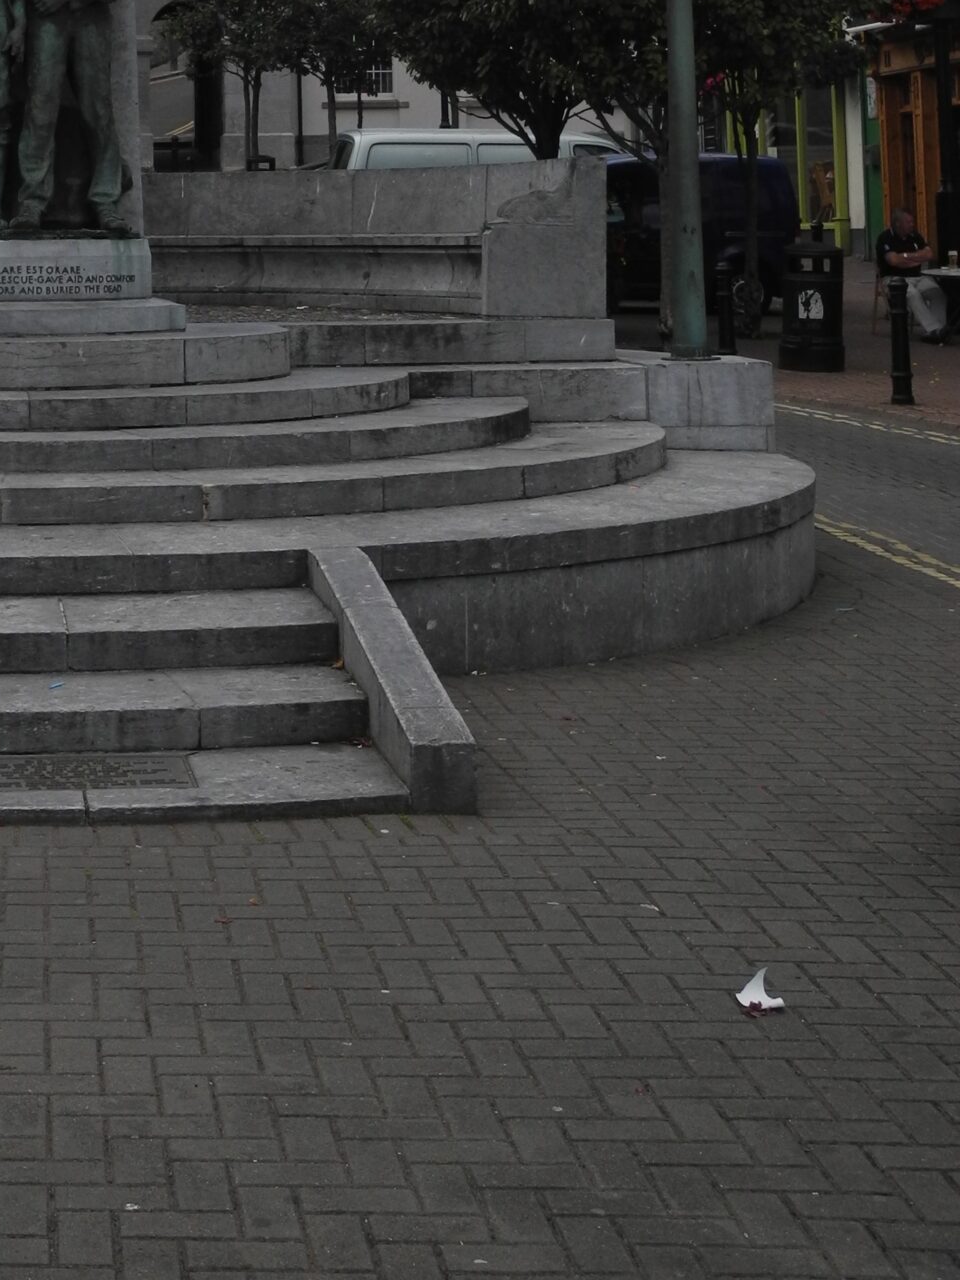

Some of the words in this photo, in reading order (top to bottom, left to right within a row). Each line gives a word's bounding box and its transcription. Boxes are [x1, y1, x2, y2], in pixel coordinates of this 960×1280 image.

[26, 265, 44, 274] EST
[45, 265, 81, 275] ORARE
[66, 275, 83, 284] AID
[84, 275, 104, 284] AND
[19, 286, 43, 295] AND
[46, 285, 80, 295] BURIED
[84, 285, 100, 294] THE
[103, 284, 123, 294] DEAD
